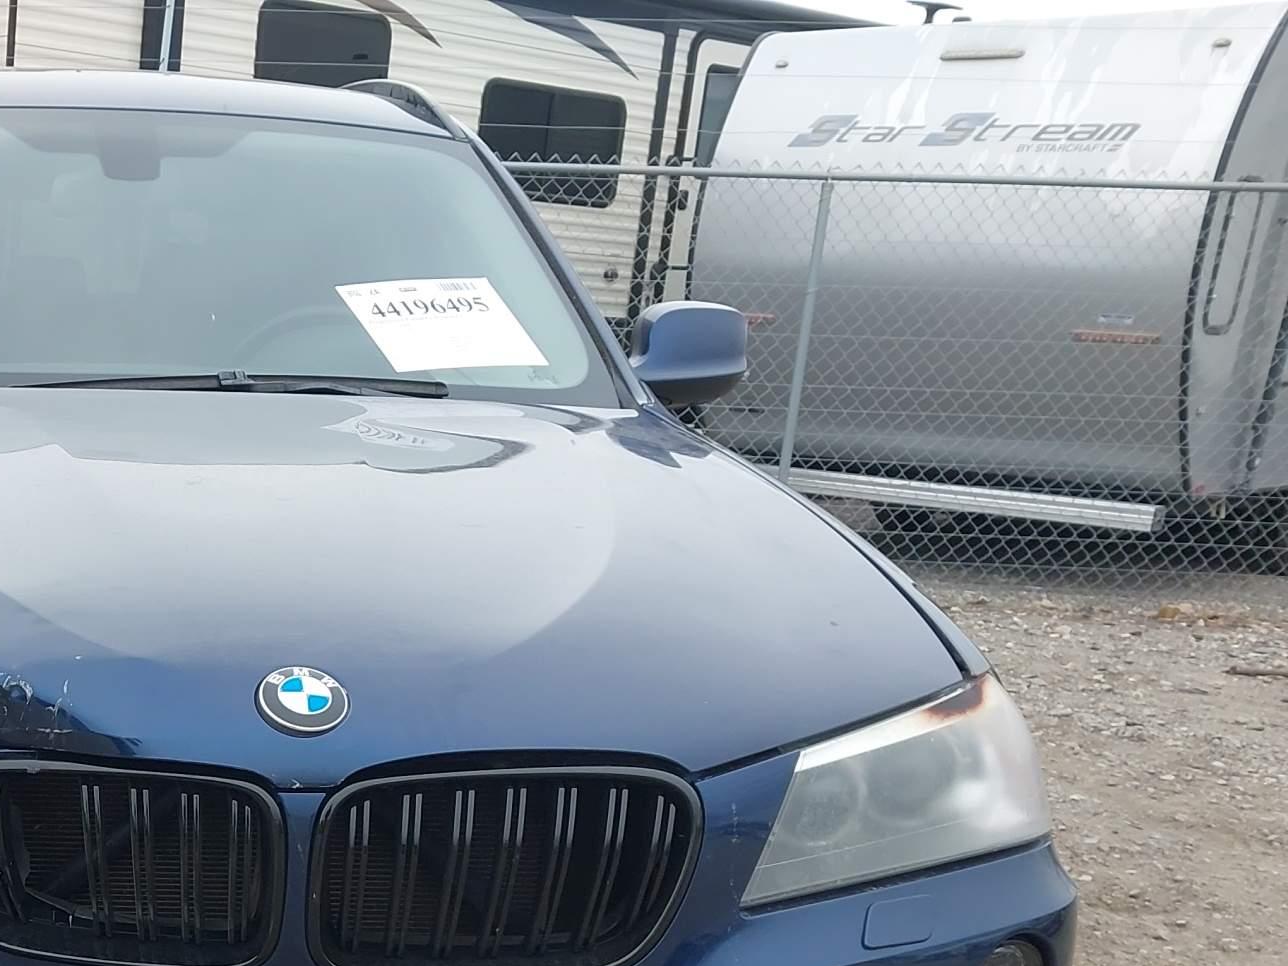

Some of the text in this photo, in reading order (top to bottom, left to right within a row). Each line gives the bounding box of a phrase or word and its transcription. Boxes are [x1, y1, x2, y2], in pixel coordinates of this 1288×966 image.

[787, 112, 1142, 147] Star Stream
[371, 296, 490, 318] 44196495
[267, 667, 338, 688] BMW
